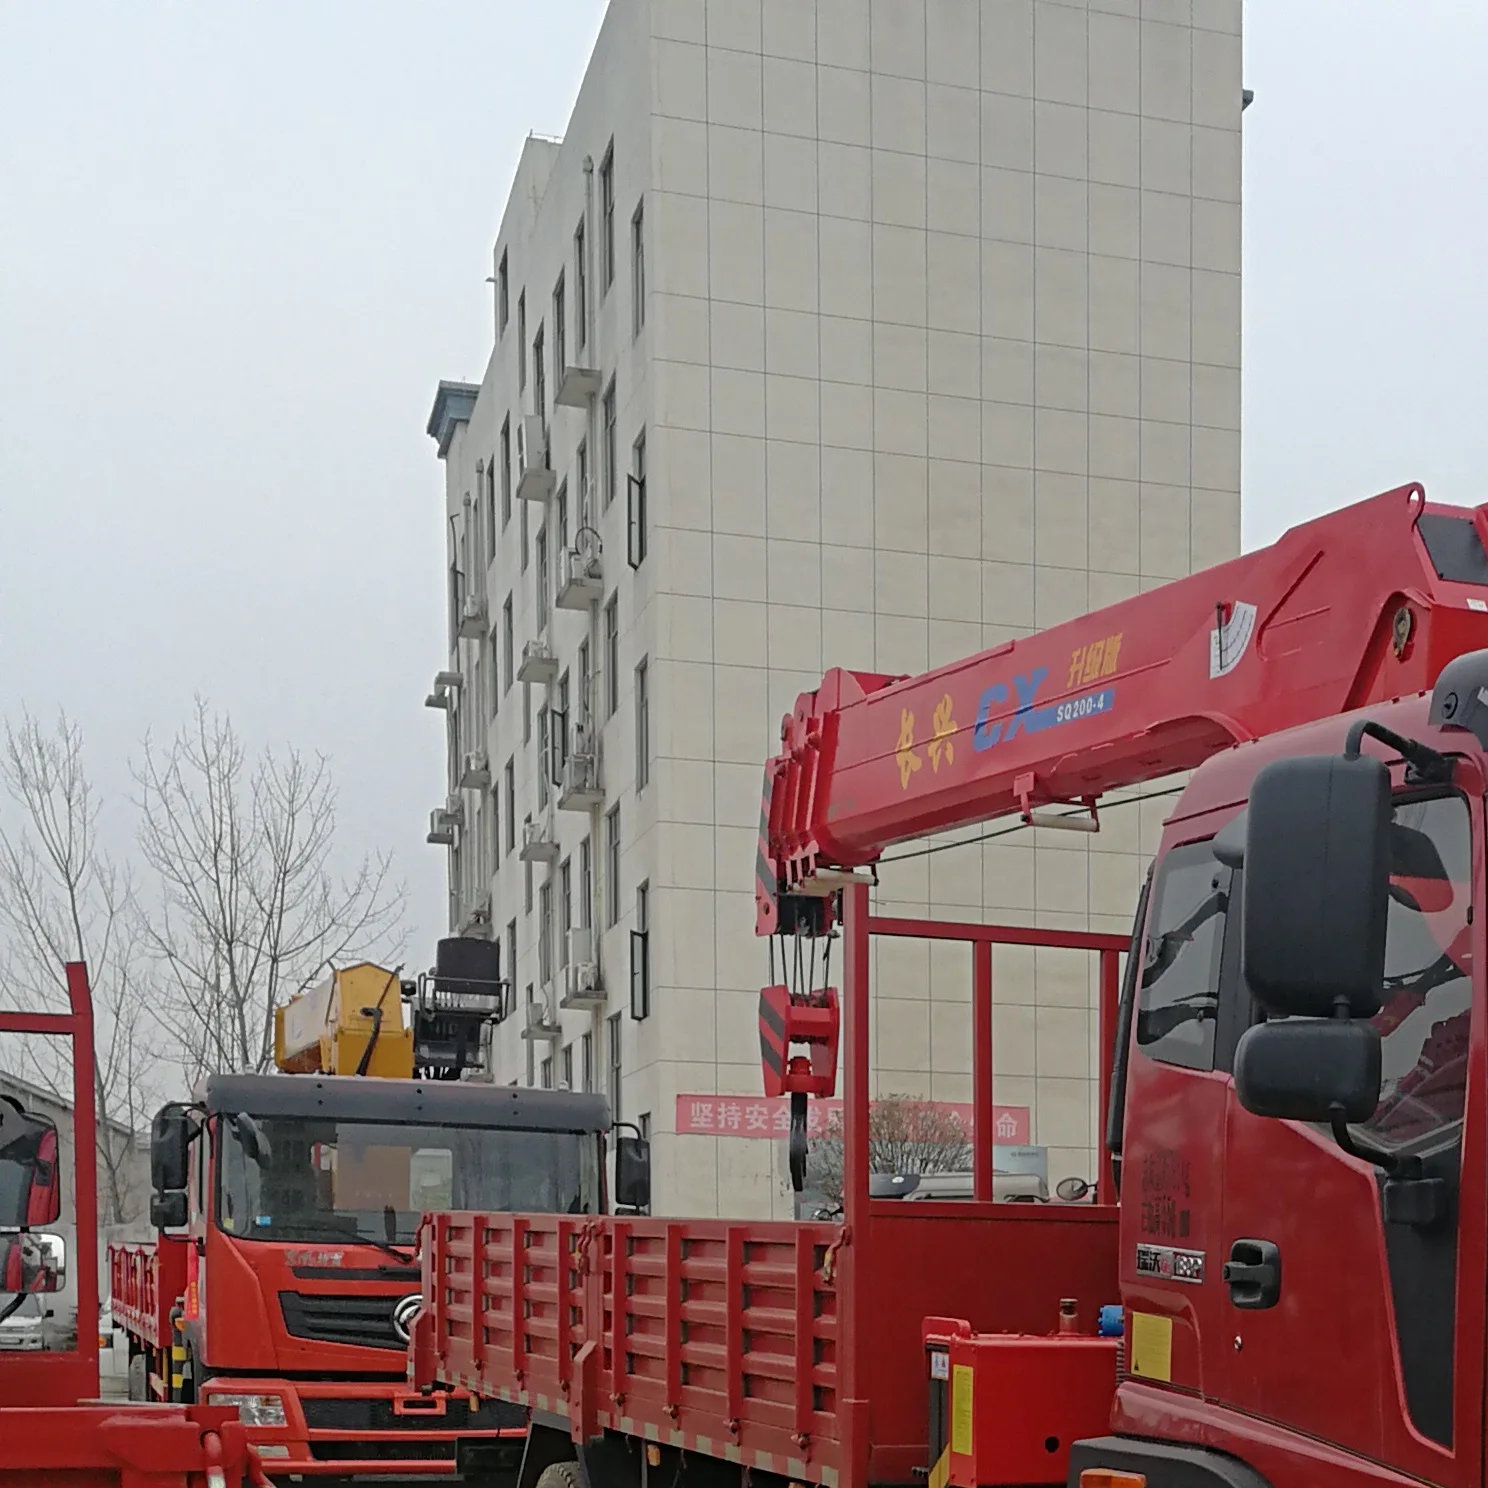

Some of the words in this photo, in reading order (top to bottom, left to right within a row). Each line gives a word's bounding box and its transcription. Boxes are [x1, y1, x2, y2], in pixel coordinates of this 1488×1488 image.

[1066, 633, 1123, 689] 升级版
[972, 666, 1048, 753] CX
[1055, 693, 1104, 723] SQ200-4
